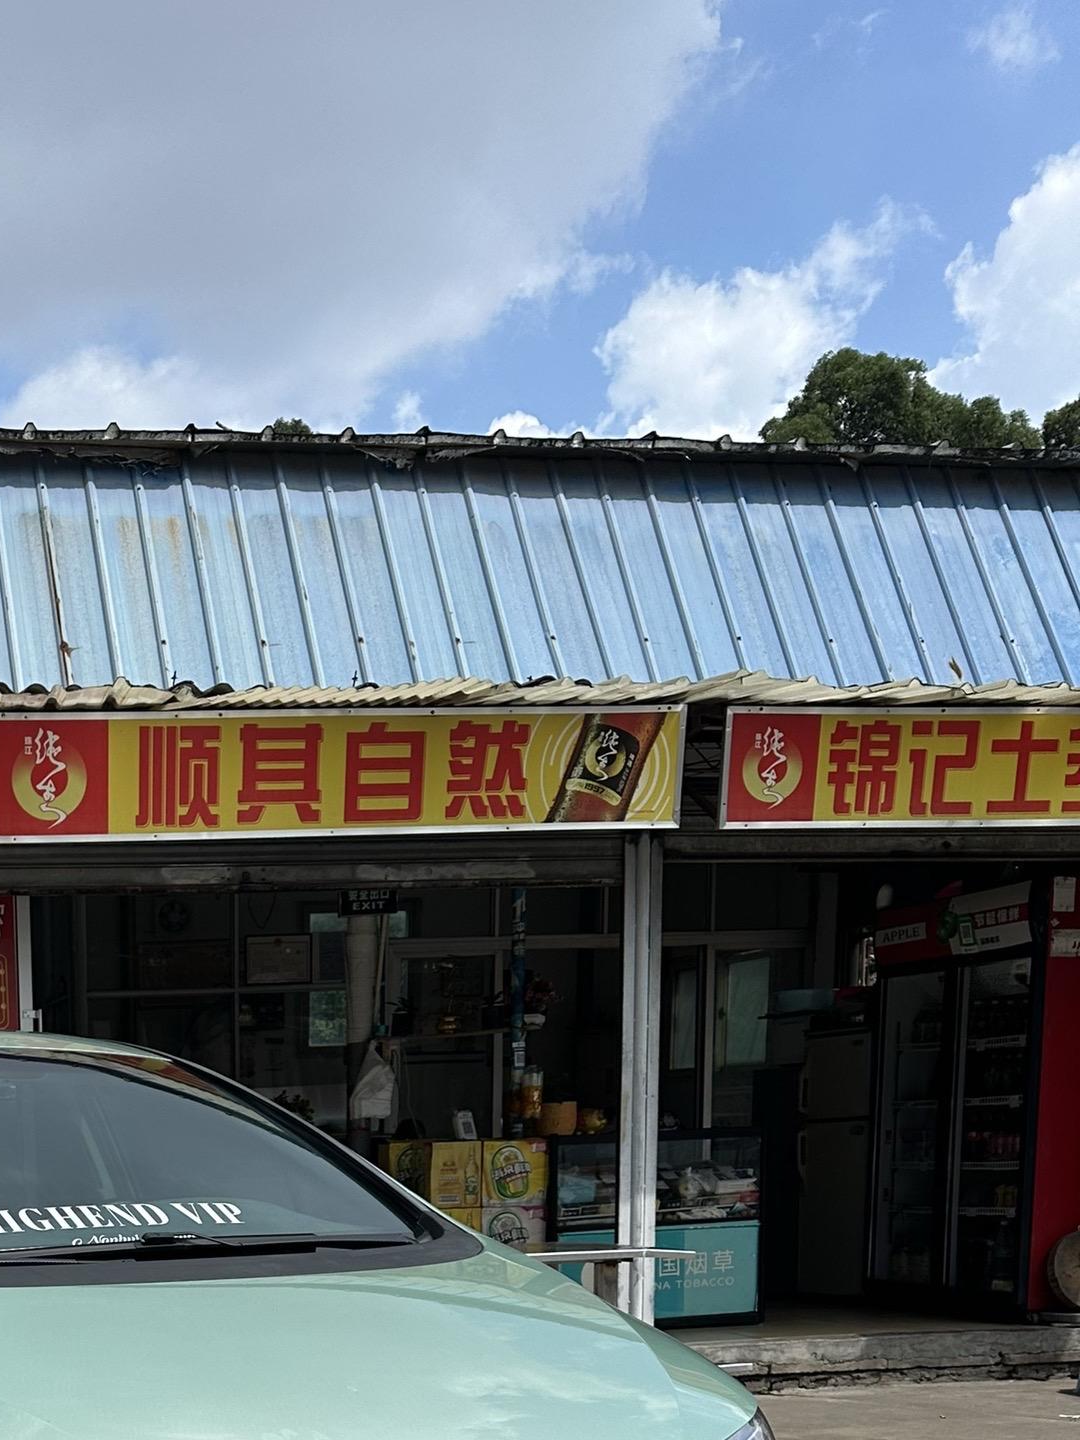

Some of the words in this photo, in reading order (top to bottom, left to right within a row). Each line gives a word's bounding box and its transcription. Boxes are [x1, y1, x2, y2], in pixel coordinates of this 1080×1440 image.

[136, 720, 531, 828] 顺其自然
[584, 782, 606, 795] 1997
[353, 901, 385, 910] EXIT
[883, 926, 920, 943] APPLE
[170, 1202, 245, 1225] VIP
[675, 1276, 735, 1289] TOBACCO
